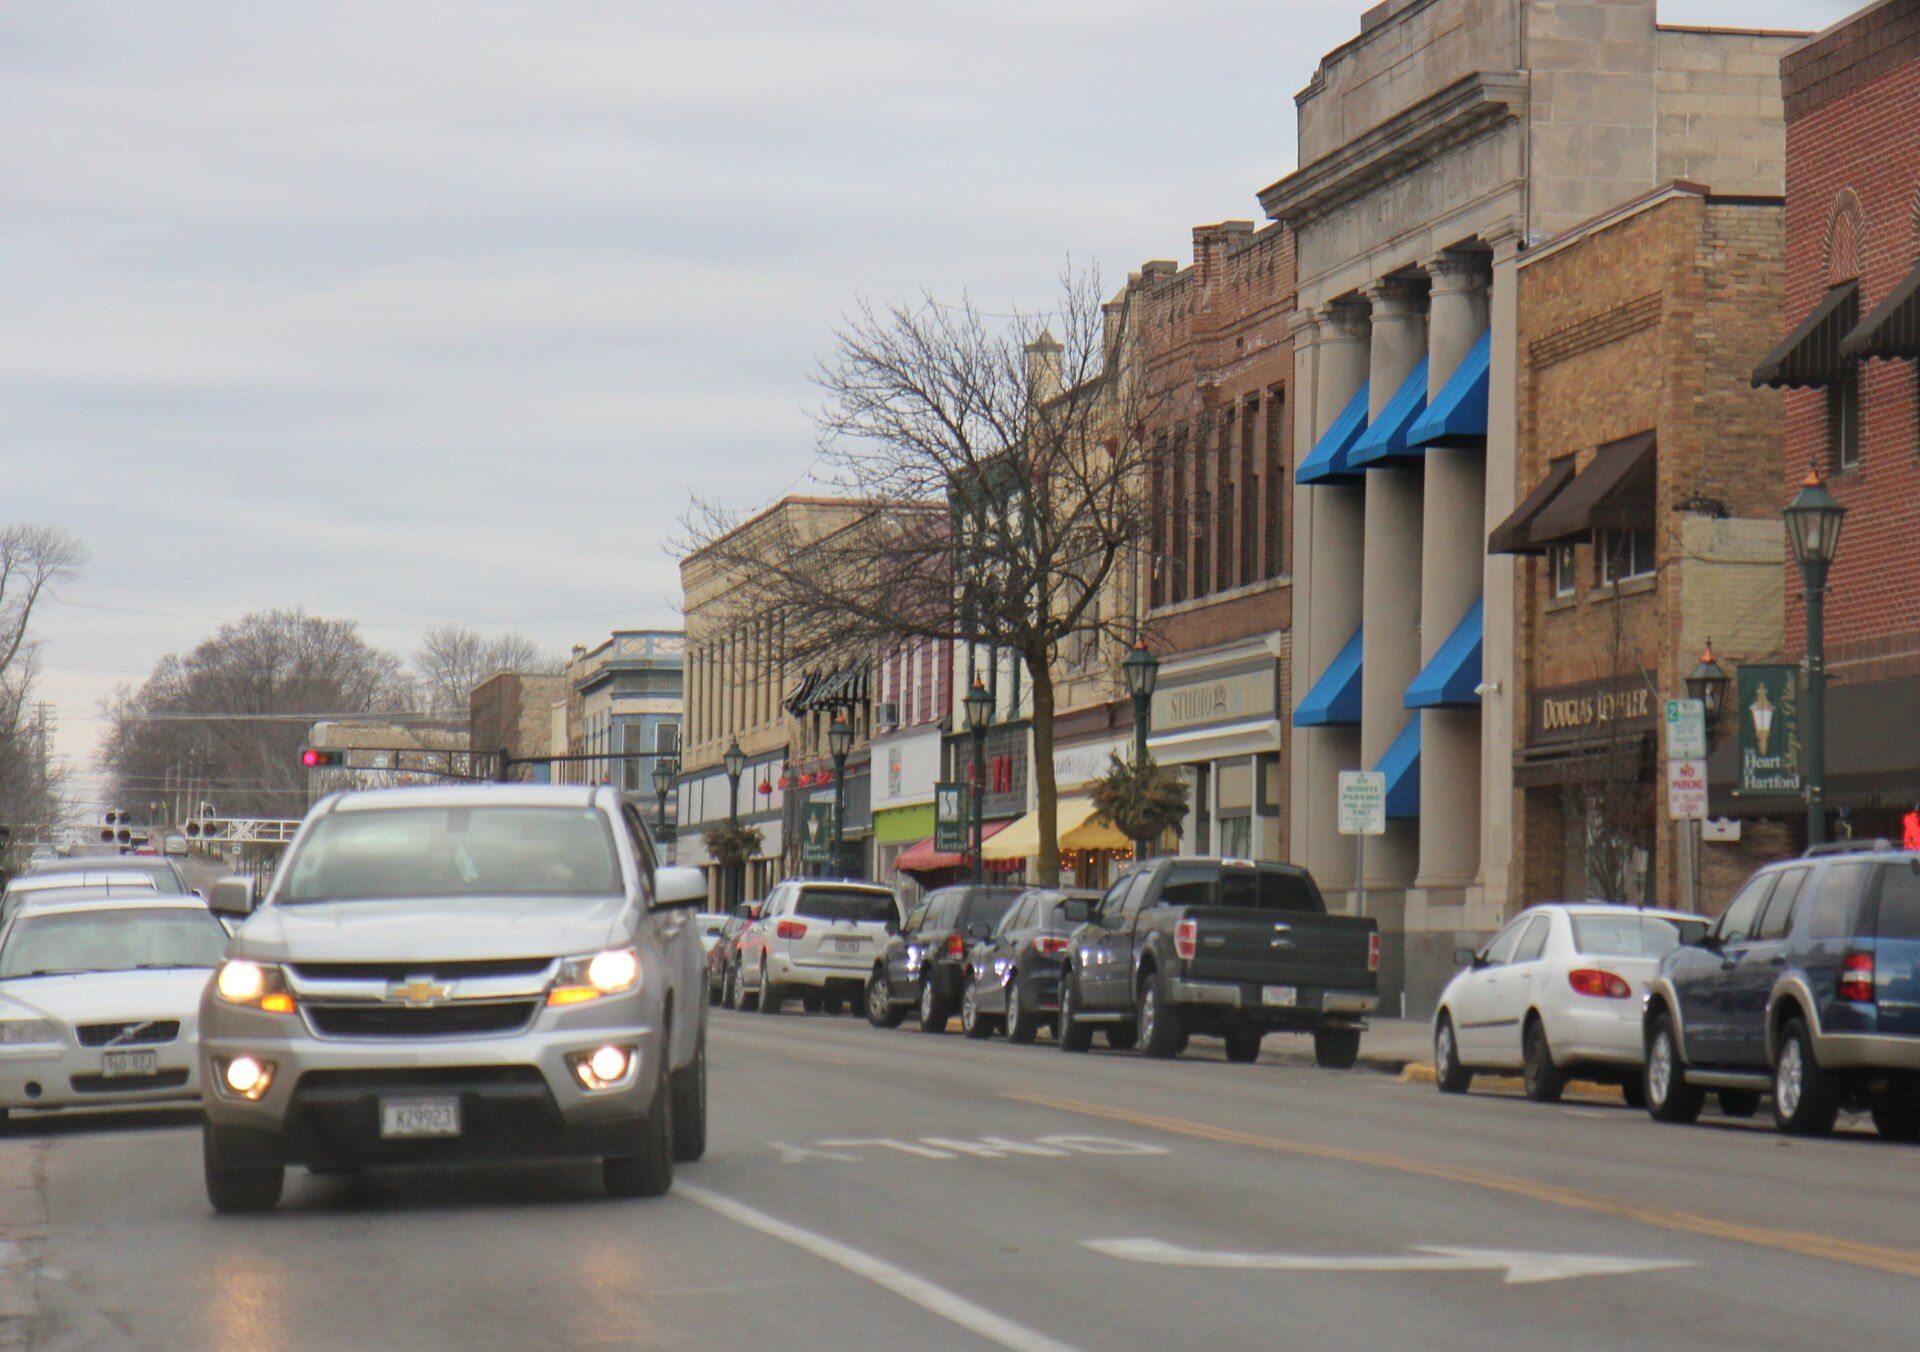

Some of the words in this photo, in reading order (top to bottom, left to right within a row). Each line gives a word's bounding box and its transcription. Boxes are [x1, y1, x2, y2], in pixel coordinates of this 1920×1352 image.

[1543, 697, 1594, 729] DOUGLAS
[1744, 754, 1780, 768] Heart
[1680, 767, 1695, 777] NO
[1672, 780, 1703, 790] PARKING
[1744, 774, 1800, 789] Hartford
